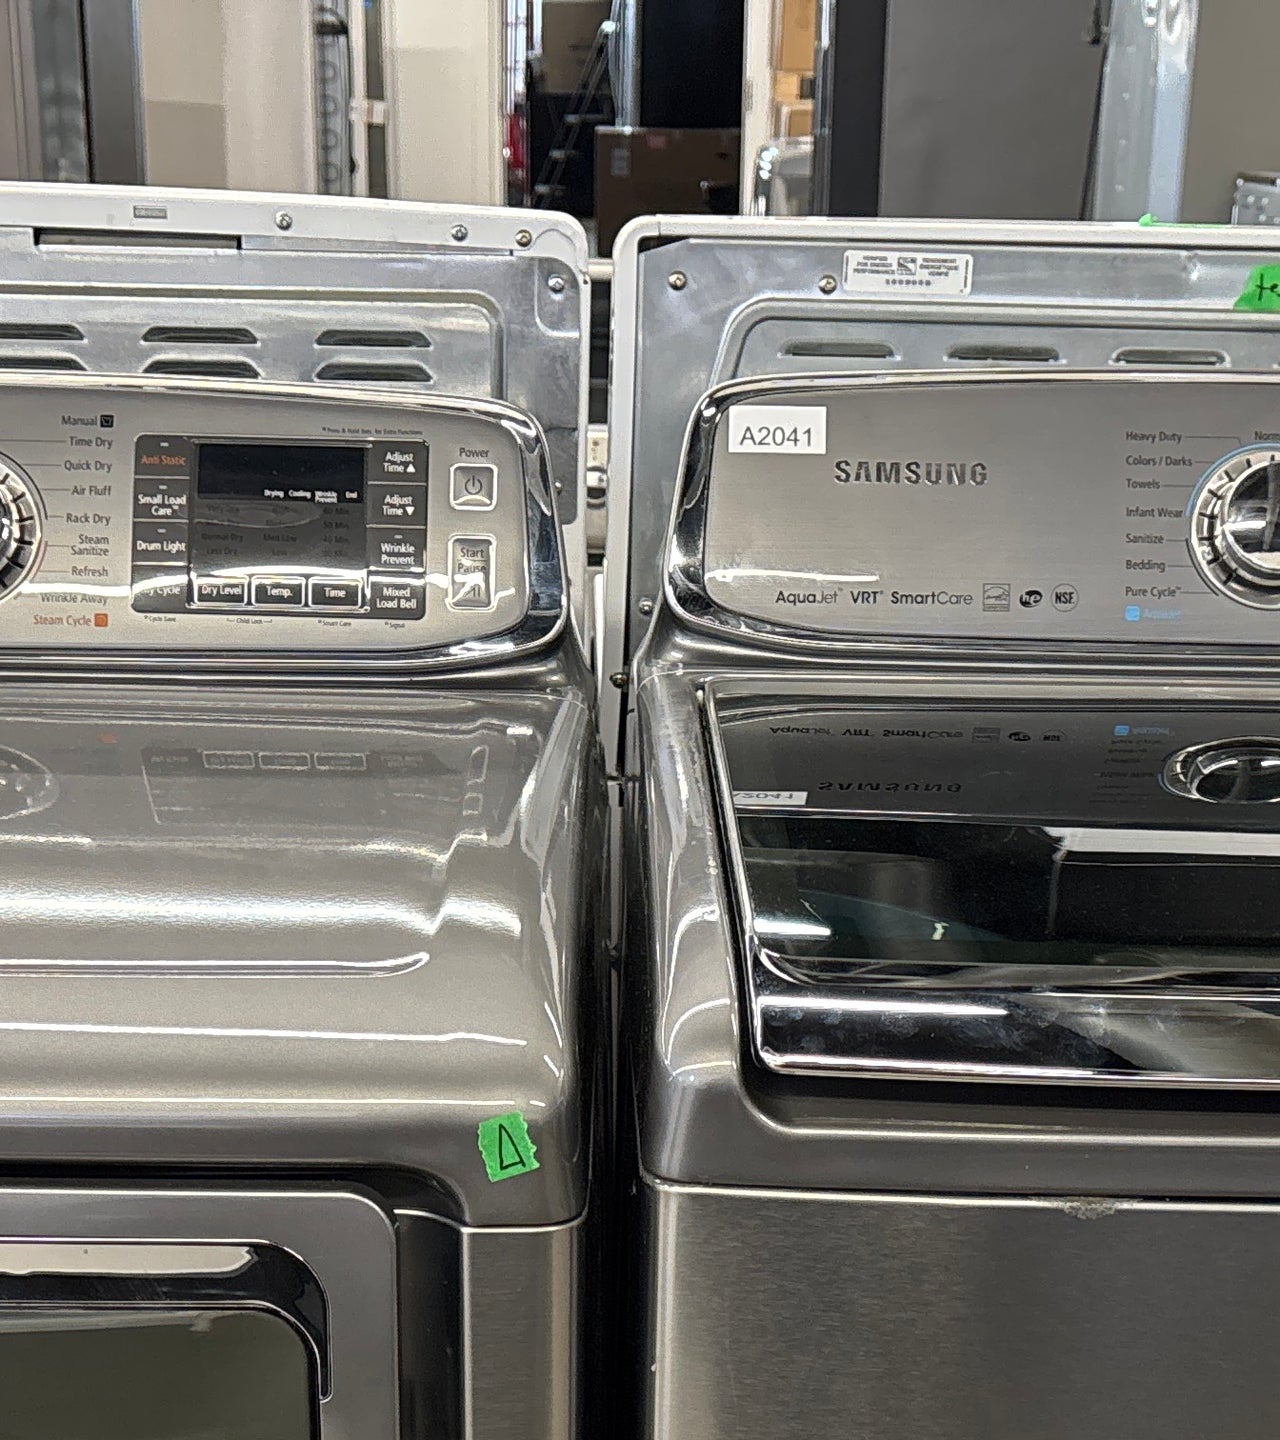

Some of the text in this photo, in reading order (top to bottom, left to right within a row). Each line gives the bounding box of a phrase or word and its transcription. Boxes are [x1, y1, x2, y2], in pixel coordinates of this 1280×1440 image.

[61, 415, 98, 426] Manual
[739, 426, 814, 448] A2041
[1126, 432, 1182, 443] Heavy Duty
[69, 437, 113, 449] Time Dry
[385, 451, 414, 463] Adjust
[459, 448, 488, 458] Power
[141, 455, 186, 466] Anti Static
[1126, 456, 1155, 466] Colors
[1165, 456, 1192, 466] Darks
[64, 460, 112, 473] Quick Dry
[383, 463, 404, 472] Time
[834, 460, 988, 486] SAMSUNG
[1126, 479, 1160, 490] Towels
[71, 485, 111, 496] Air Fluff
[138, 494, 186, 505] Small Load
[384, 494, 412, 505] Adjust
[382, 505, 403, 516] Time
[1126, 507, 1182, 518] Infant Wear
[66, 513, 111, 526] Rack Dry
[78, 534, 109, 545] Steam
[1125, 534, 1164, 544] Sanitize
[70, 545, 109, 556] Sanitize
[136, 541, 186, 554] Drum Light
[381, 543, 414, 554] Wrinkle
[460, 548, 484, 558] Start
[381, 554, 414, 566] Prevent
[71, 566, 108, 577] Refresh
[457, 563, 487, 572] Pause
[1125, 560, 1165, 572] Bedding
[201, 585, 242, 597] Dry Level
[266, 586, 292, 598] Temp.
[323, 587, 346, 598] Time
[383, 586, 410, 597] Mixed
[1125, 586, 1148, 596] Pure
[40, 592, 108, 605] Wrinkle Away
[376, 598, 416, 608] Load Bell
[891, 591, 974, 606] SmartCare
[33, 615, 92, 627] Steam Cycle
